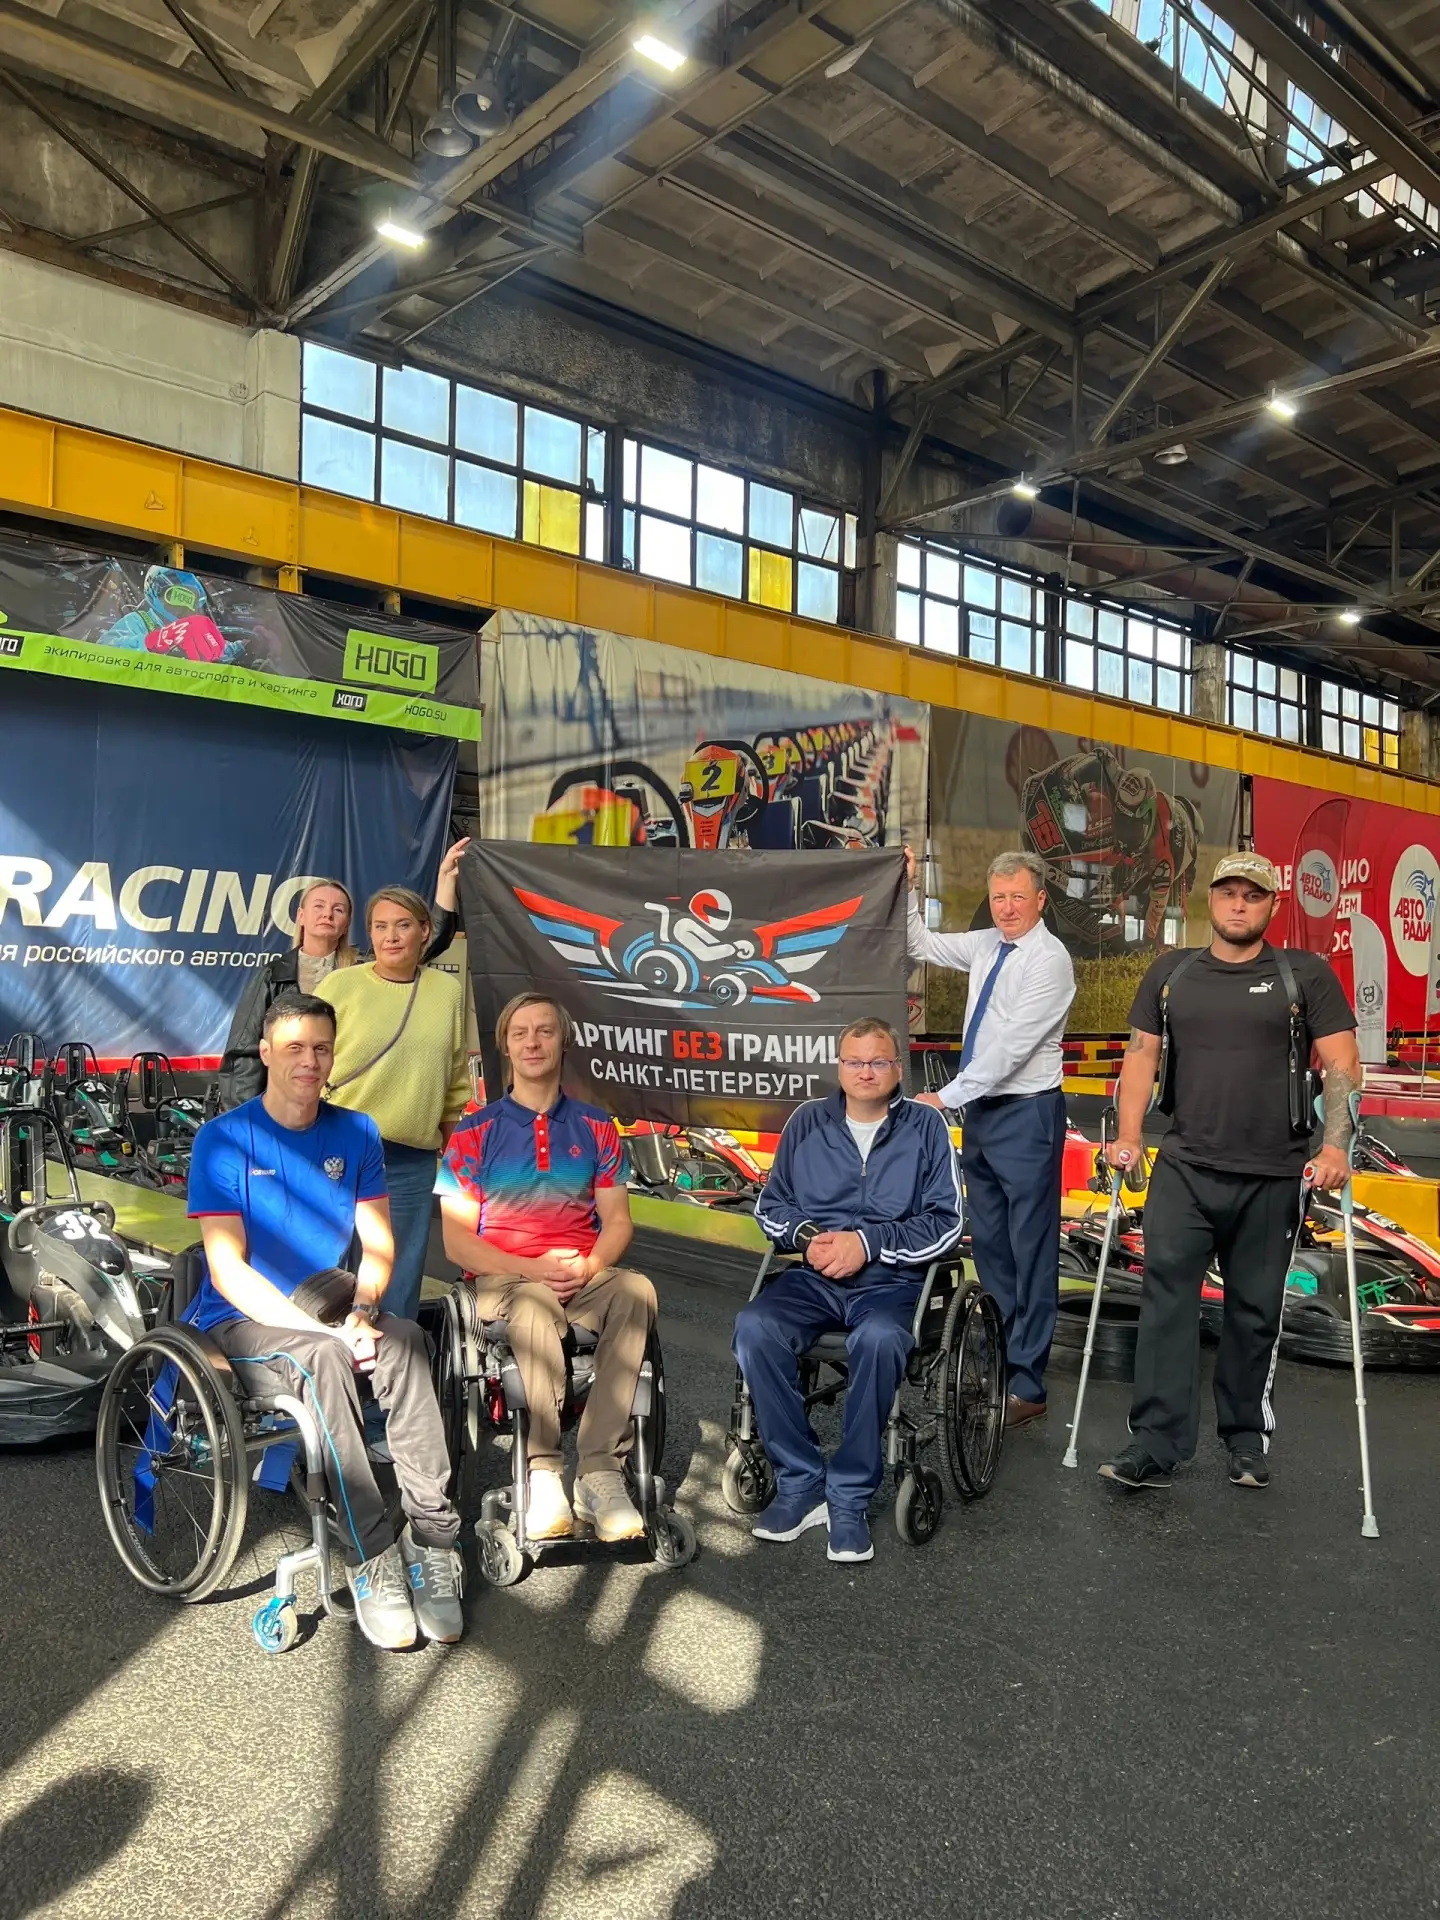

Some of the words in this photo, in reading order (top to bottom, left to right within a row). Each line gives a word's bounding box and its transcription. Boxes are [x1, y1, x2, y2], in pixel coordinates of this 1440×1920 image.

[0, 635, 18, 653] ГО
[43, 645, 131, 667] экипировка
[133, 661, 162, 673] для
[165, 667, 245, 685] автоспорта
[248, 679, 257, 687] и
[260, 681, 318, 698] картинга
[355, 643, 427, 681] HOGO
[404, 705, 448, 722] HOGO.SU
[700, 763, 722, 792] 2
[1303, 884, 1332, 904] РАДИО
[1393, 897, 1425, 921] АВТО
[1403, 920, 1432, 943] РАДИ
[0, 944, 19, 961] я
[23, 943, 184, 968] российского
[572, 1021, 668, 1057] АРТИНГ
[672, 1030, 723, 1061] БЕЗ
[590, 1058, 820, 1097] САНКТ-ПЕТЕРБУРГ
[55, 1211, 112, 1241] 32
